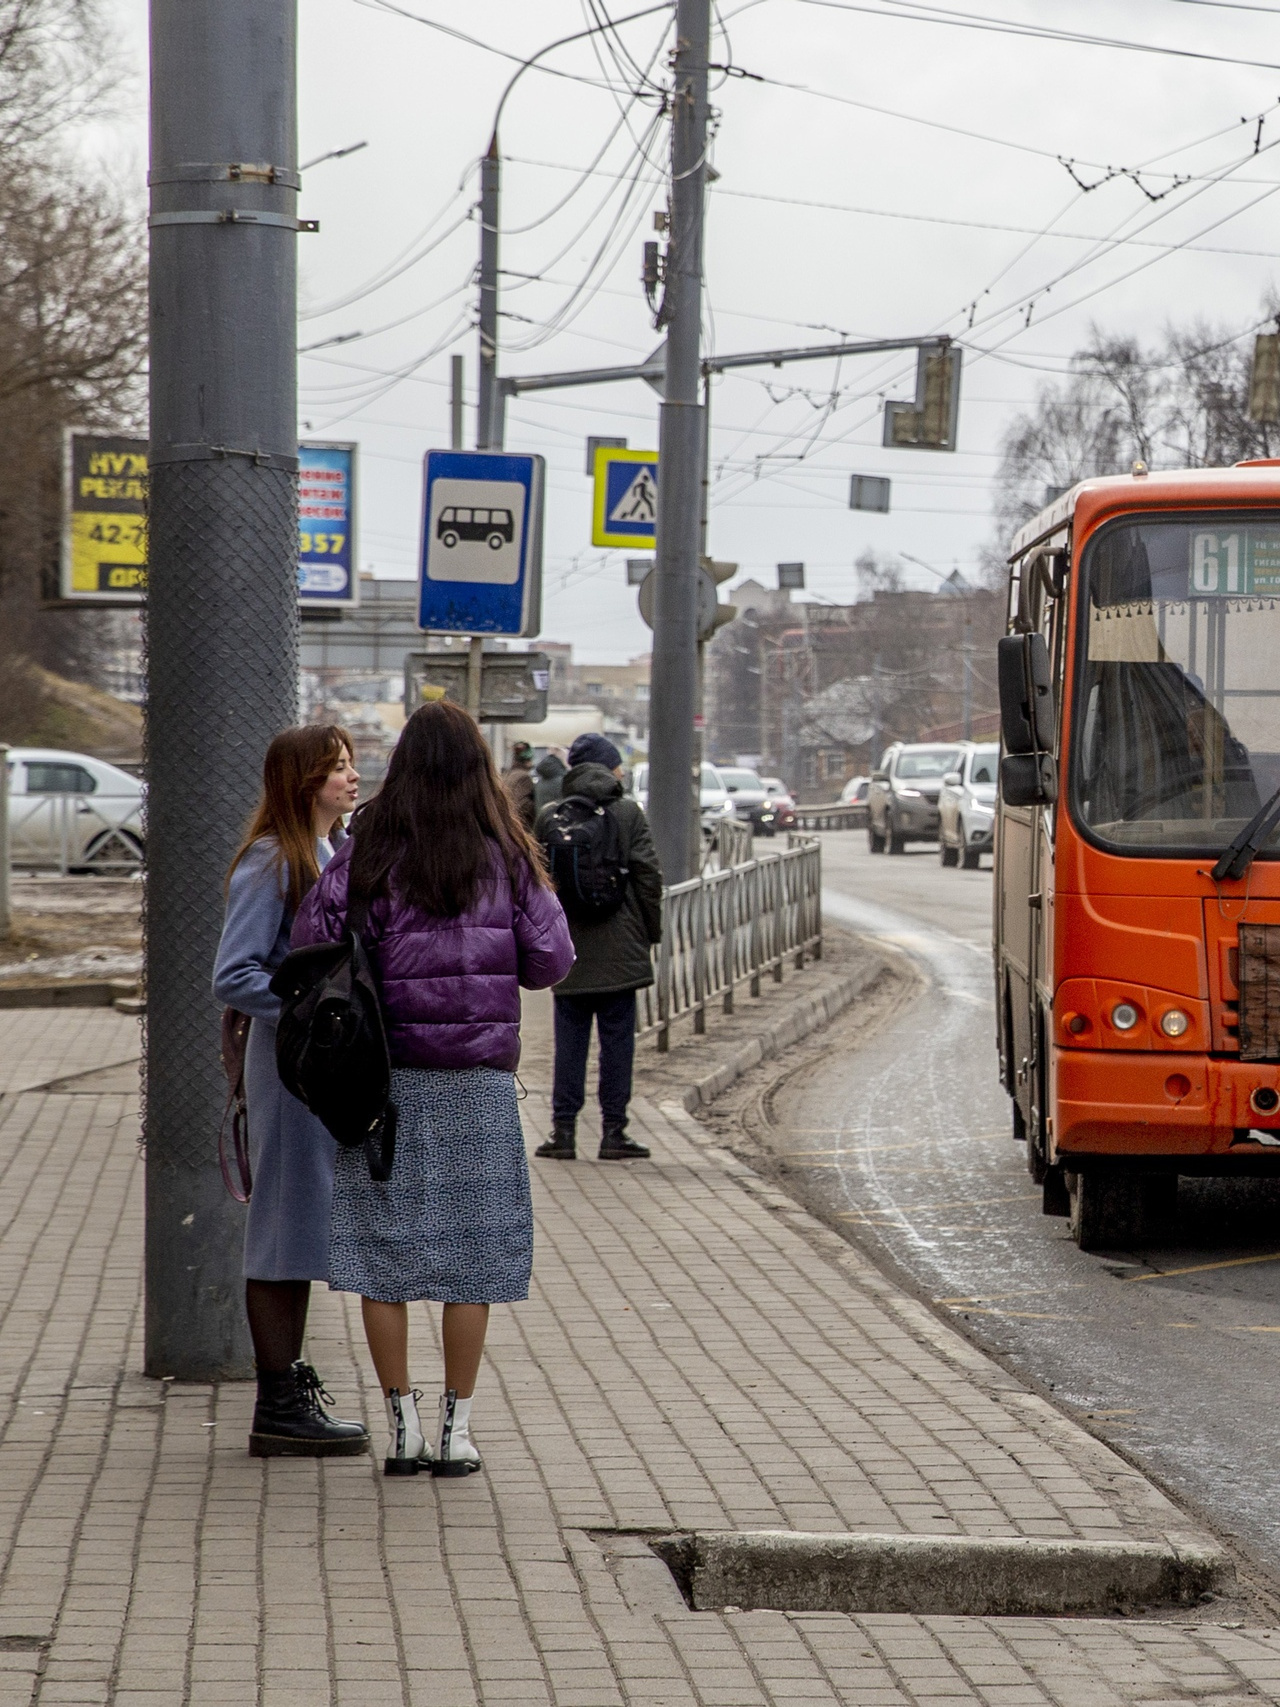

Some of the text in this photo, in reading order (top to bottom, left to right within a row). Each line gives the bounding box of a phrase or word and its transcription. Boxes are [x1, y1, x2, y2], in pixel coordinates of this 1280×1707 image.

[89, 452, 149, 475] НУЖ
[79, 475, 148, 500] РЕКЛ
[1193, 533, 1239, 592] 61
